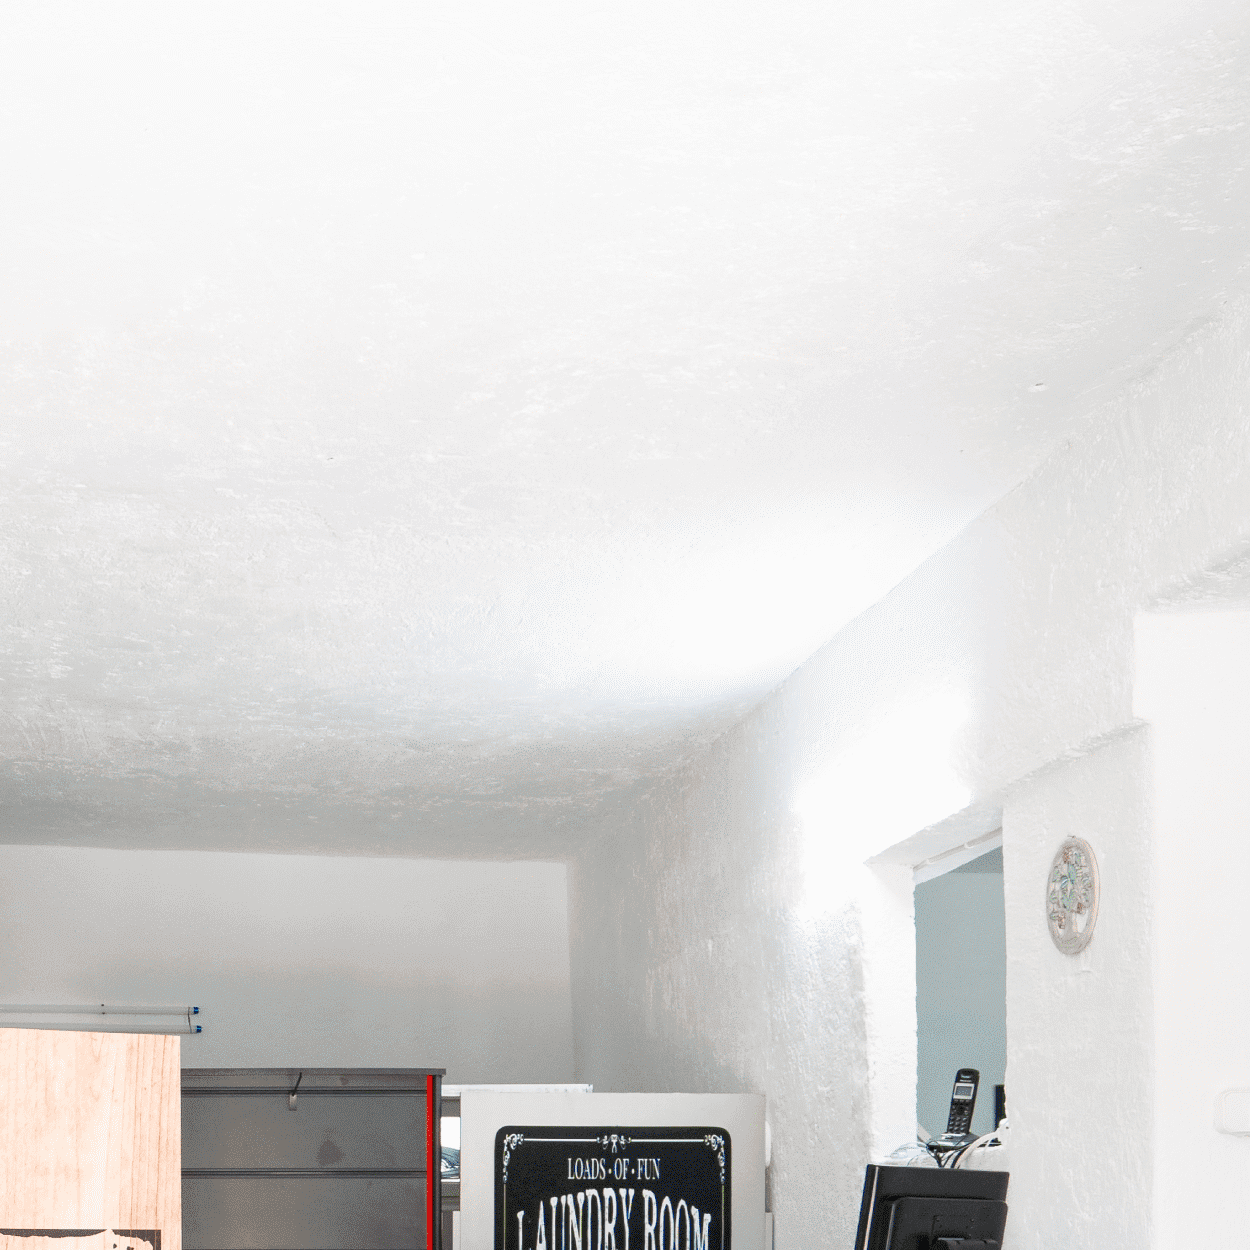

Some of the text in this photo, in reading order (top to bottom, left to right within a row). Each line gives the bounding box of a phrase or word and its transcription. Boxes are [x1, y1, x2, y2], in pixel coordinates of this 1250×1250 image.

[568, 1158, 661, 1180] LOADS OF FUN
